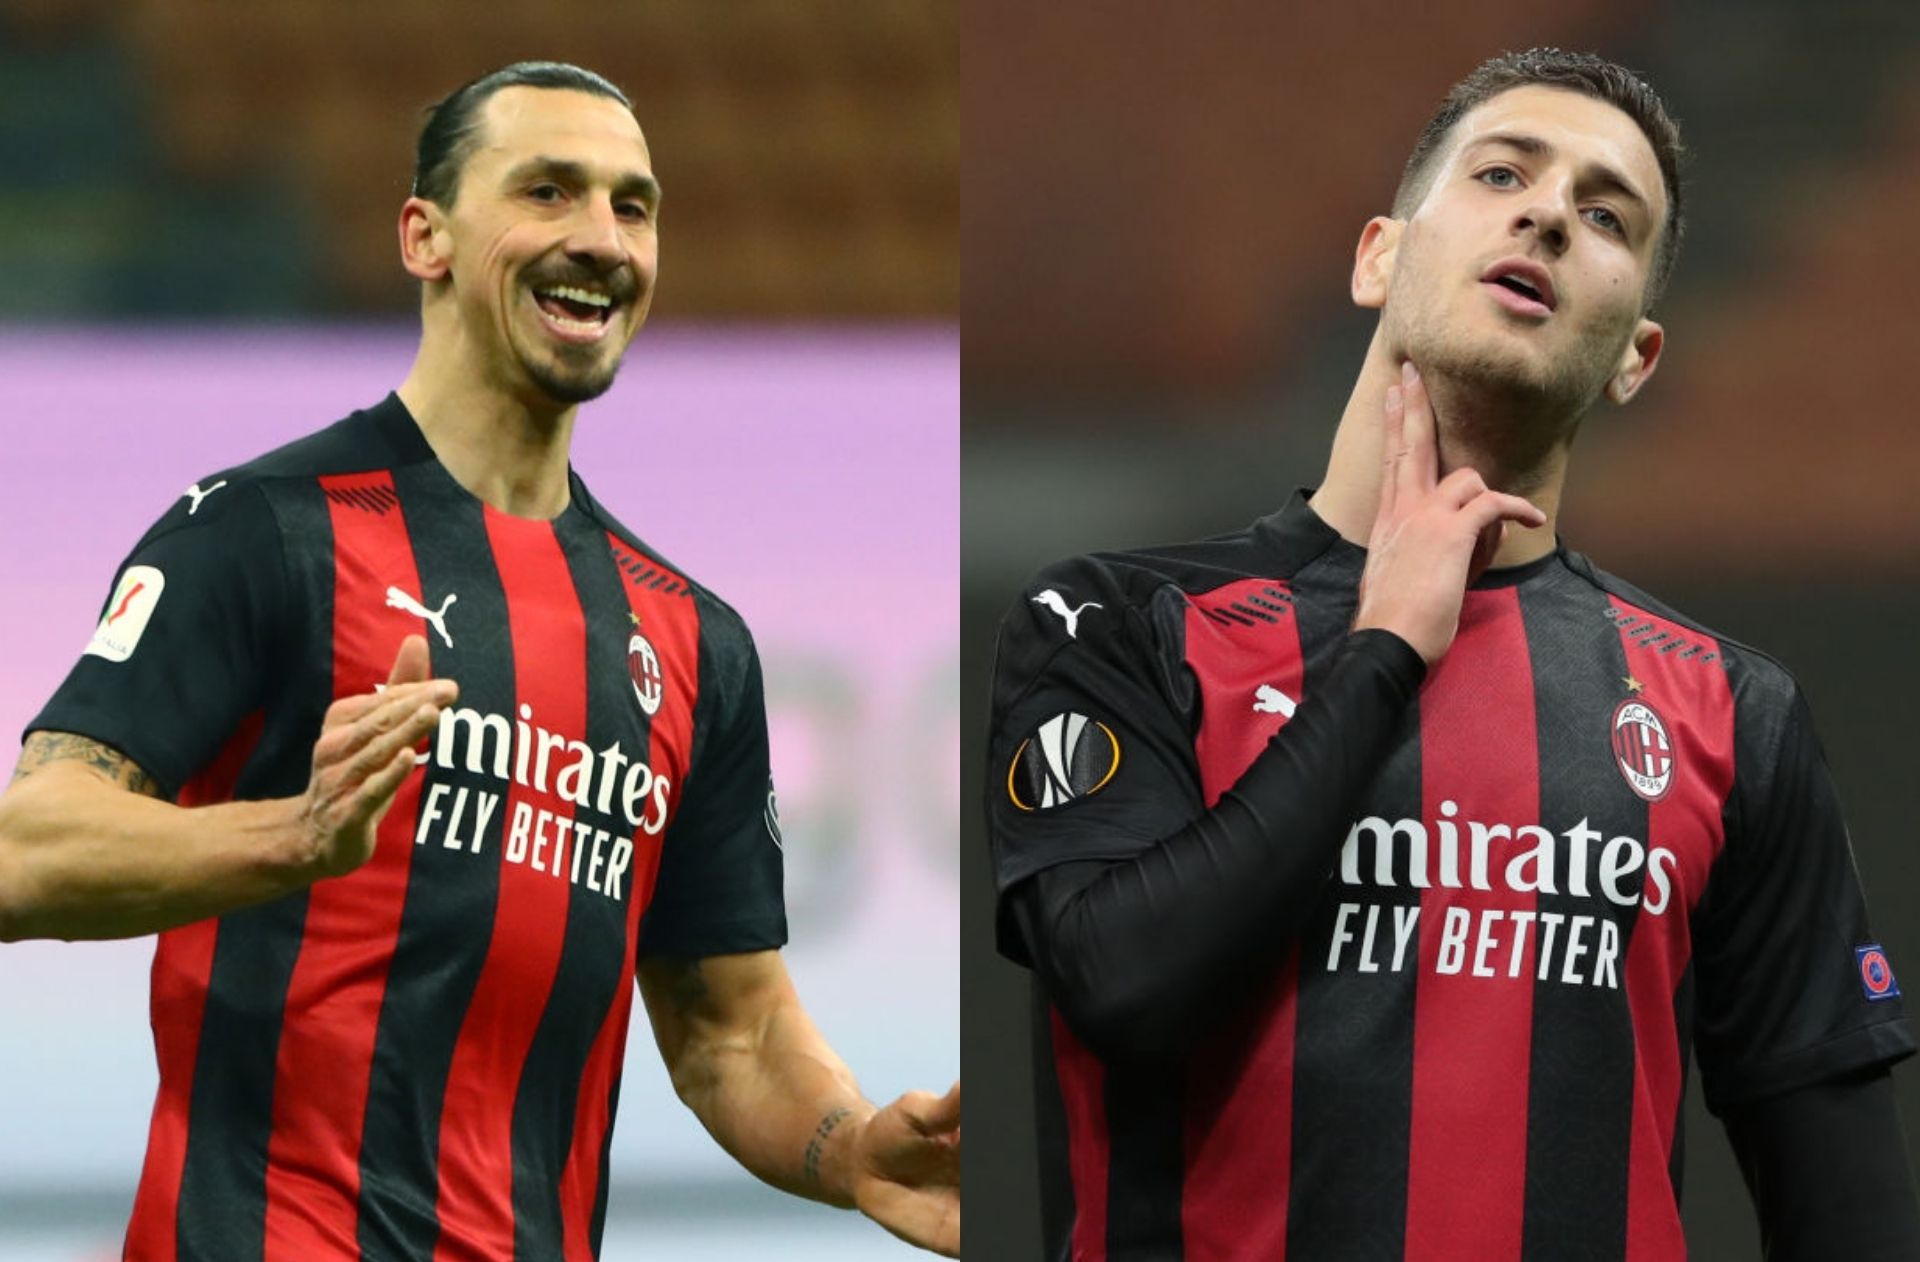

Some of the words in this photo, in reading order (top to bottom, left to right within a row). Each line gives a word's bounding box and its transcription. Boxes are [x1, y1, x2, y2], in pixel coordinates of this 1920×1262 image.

[375, 684, 671, 835] mirates
[415, 783, 499, 854] FLY
[505, 801, 634, 901] BETTER
[1329, 799, 1676, 916] mirates
[1326, 903, 1421, 973] FLY
[1435, 905, 1619, 990] BETTER
